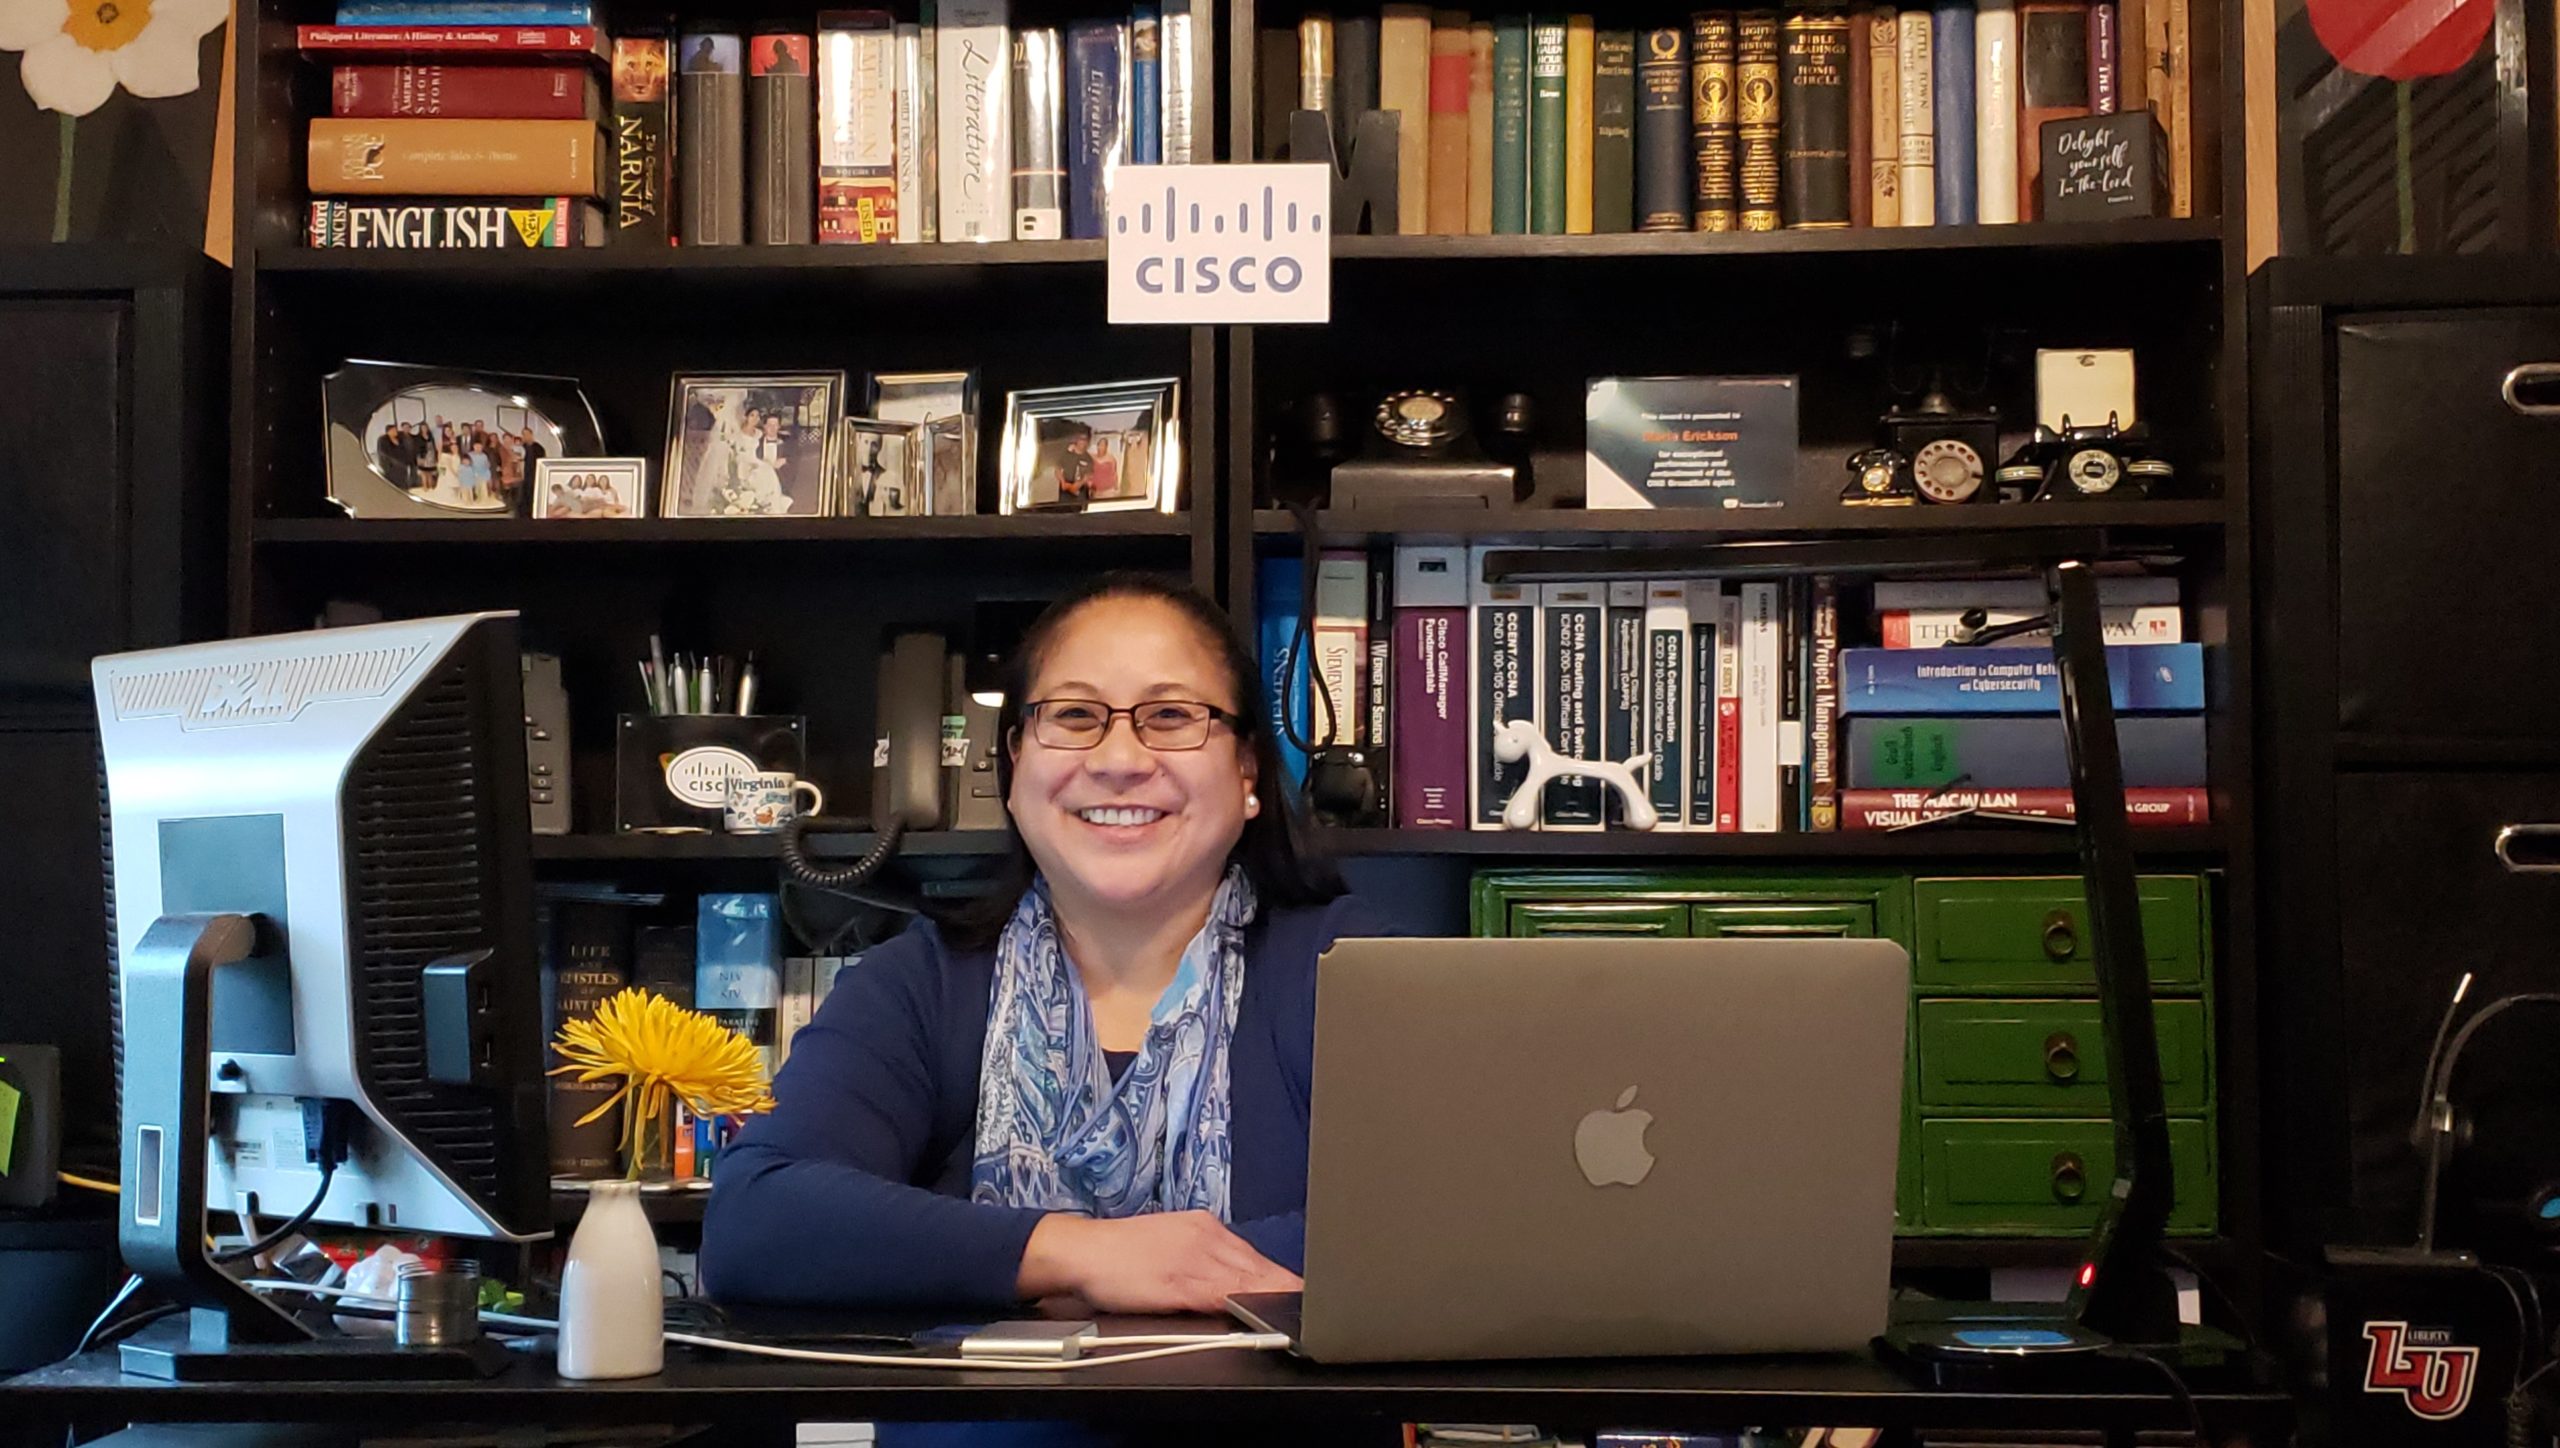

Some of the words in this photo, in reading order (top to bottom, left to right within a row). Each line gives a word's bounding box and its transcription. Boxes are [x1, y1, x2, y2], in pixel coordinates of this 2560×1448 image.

[411, 32, 444, 43] History
[446, 32, 455, 42] &
[456, 32, 499, 43] Anthology
[1789, 45, 1846, 54] READINGS
[1798, 34, 1836, 44] BIBLE
[1793, 75, 1841, 85] CIRCLE
[1798, 65, 1836, 75] HOME
[2099, 64, 2111, 93] THE
[399, 66, 413, 115] AMERICA
[1919, 71, 1928, 109] TOWN
[962, 39, 990, 200] Literature
[1088, 70, 1104, 156] Literature
[901, 125, 911, 193] DICKINSON
[2058, 127, 2114, 158] Delight
[2069, 140, 2129, 178] yourself
[616, 115, 643, 230] NARNIA
[2058, 178, 2074, 197] In
[2102, 165, 2134, 192] Lord
[309, 200, 329, 248] xford
[350, 206, 509, 248] ENGLISH
[525, 212, 538, 241] New
[861, 203, 875, 238] USED
[1136, 256, 1302, 294] CISCO
[1682, 430, 1739, 442] Erickson
[1560, 613, 1571, 647] ICND2
[1759, 592, 1769, 633] SIEMENS
[1437, 617, 1448, 649] Cisco
[1574, 612, 1585, 650] CCNA
[1620, 618, 1631, 671] Applications
[1372, 642, 1388, 686] WERNER
[1425, 617, 1436, 694] Fundamentals
[1506, 611, 1519, 698] CCENT/CCNA
[1666, 634, 1677, 668] CCNA
[1812, 638, 1836, 691] Project
[1326, 647, 1349, 694] SIEMENS
[1436, 650, 1449, 720] CallManager
[1493, 649, 1504, 689] 100-105
[1560, 648, 1571, 692] 200-105
[1572, 652, 1585, 699] Routing
[1654, 660, 1665, 700] 210-060
[1722, 666, 1733, 695] SERVE
[1917, 665, 1977, 678] Introduction
[1987, 664, 2033, 678] Computer
[1972, 678, 2041, 692] Cybersecurity
[1630, 678, 1640, 703] Cisco
[1666, 669, 1677, 743] Collaboration
[1372, 705, 1385, 745] SIEMENS
[1560, 694, 1571, 729] Official
[1574, 701, 1585, 724] and
[1654, 701, 1665, 731] Official
[1560, 730, 1571, 753] Cert
[1654, 733, 1665, 753] Cert
[1812, 694, 1836, 784] Management
[730, 776, 785, 792] Virginia
[1653, 753, 1664, 781] Guide
[688, 780, 724, 792] CISC
[1892, 793, 1921, 808] THE
[1922, 792, 2018, 809] MACMILLAN
[1864, 811, 1918, 827] VISUAL
[2134, 803, 2171, 814] GROUP
[2408, 1330, 2451, 1342] LIBERTY
[2362, 1321, 2480, 1421] LU
